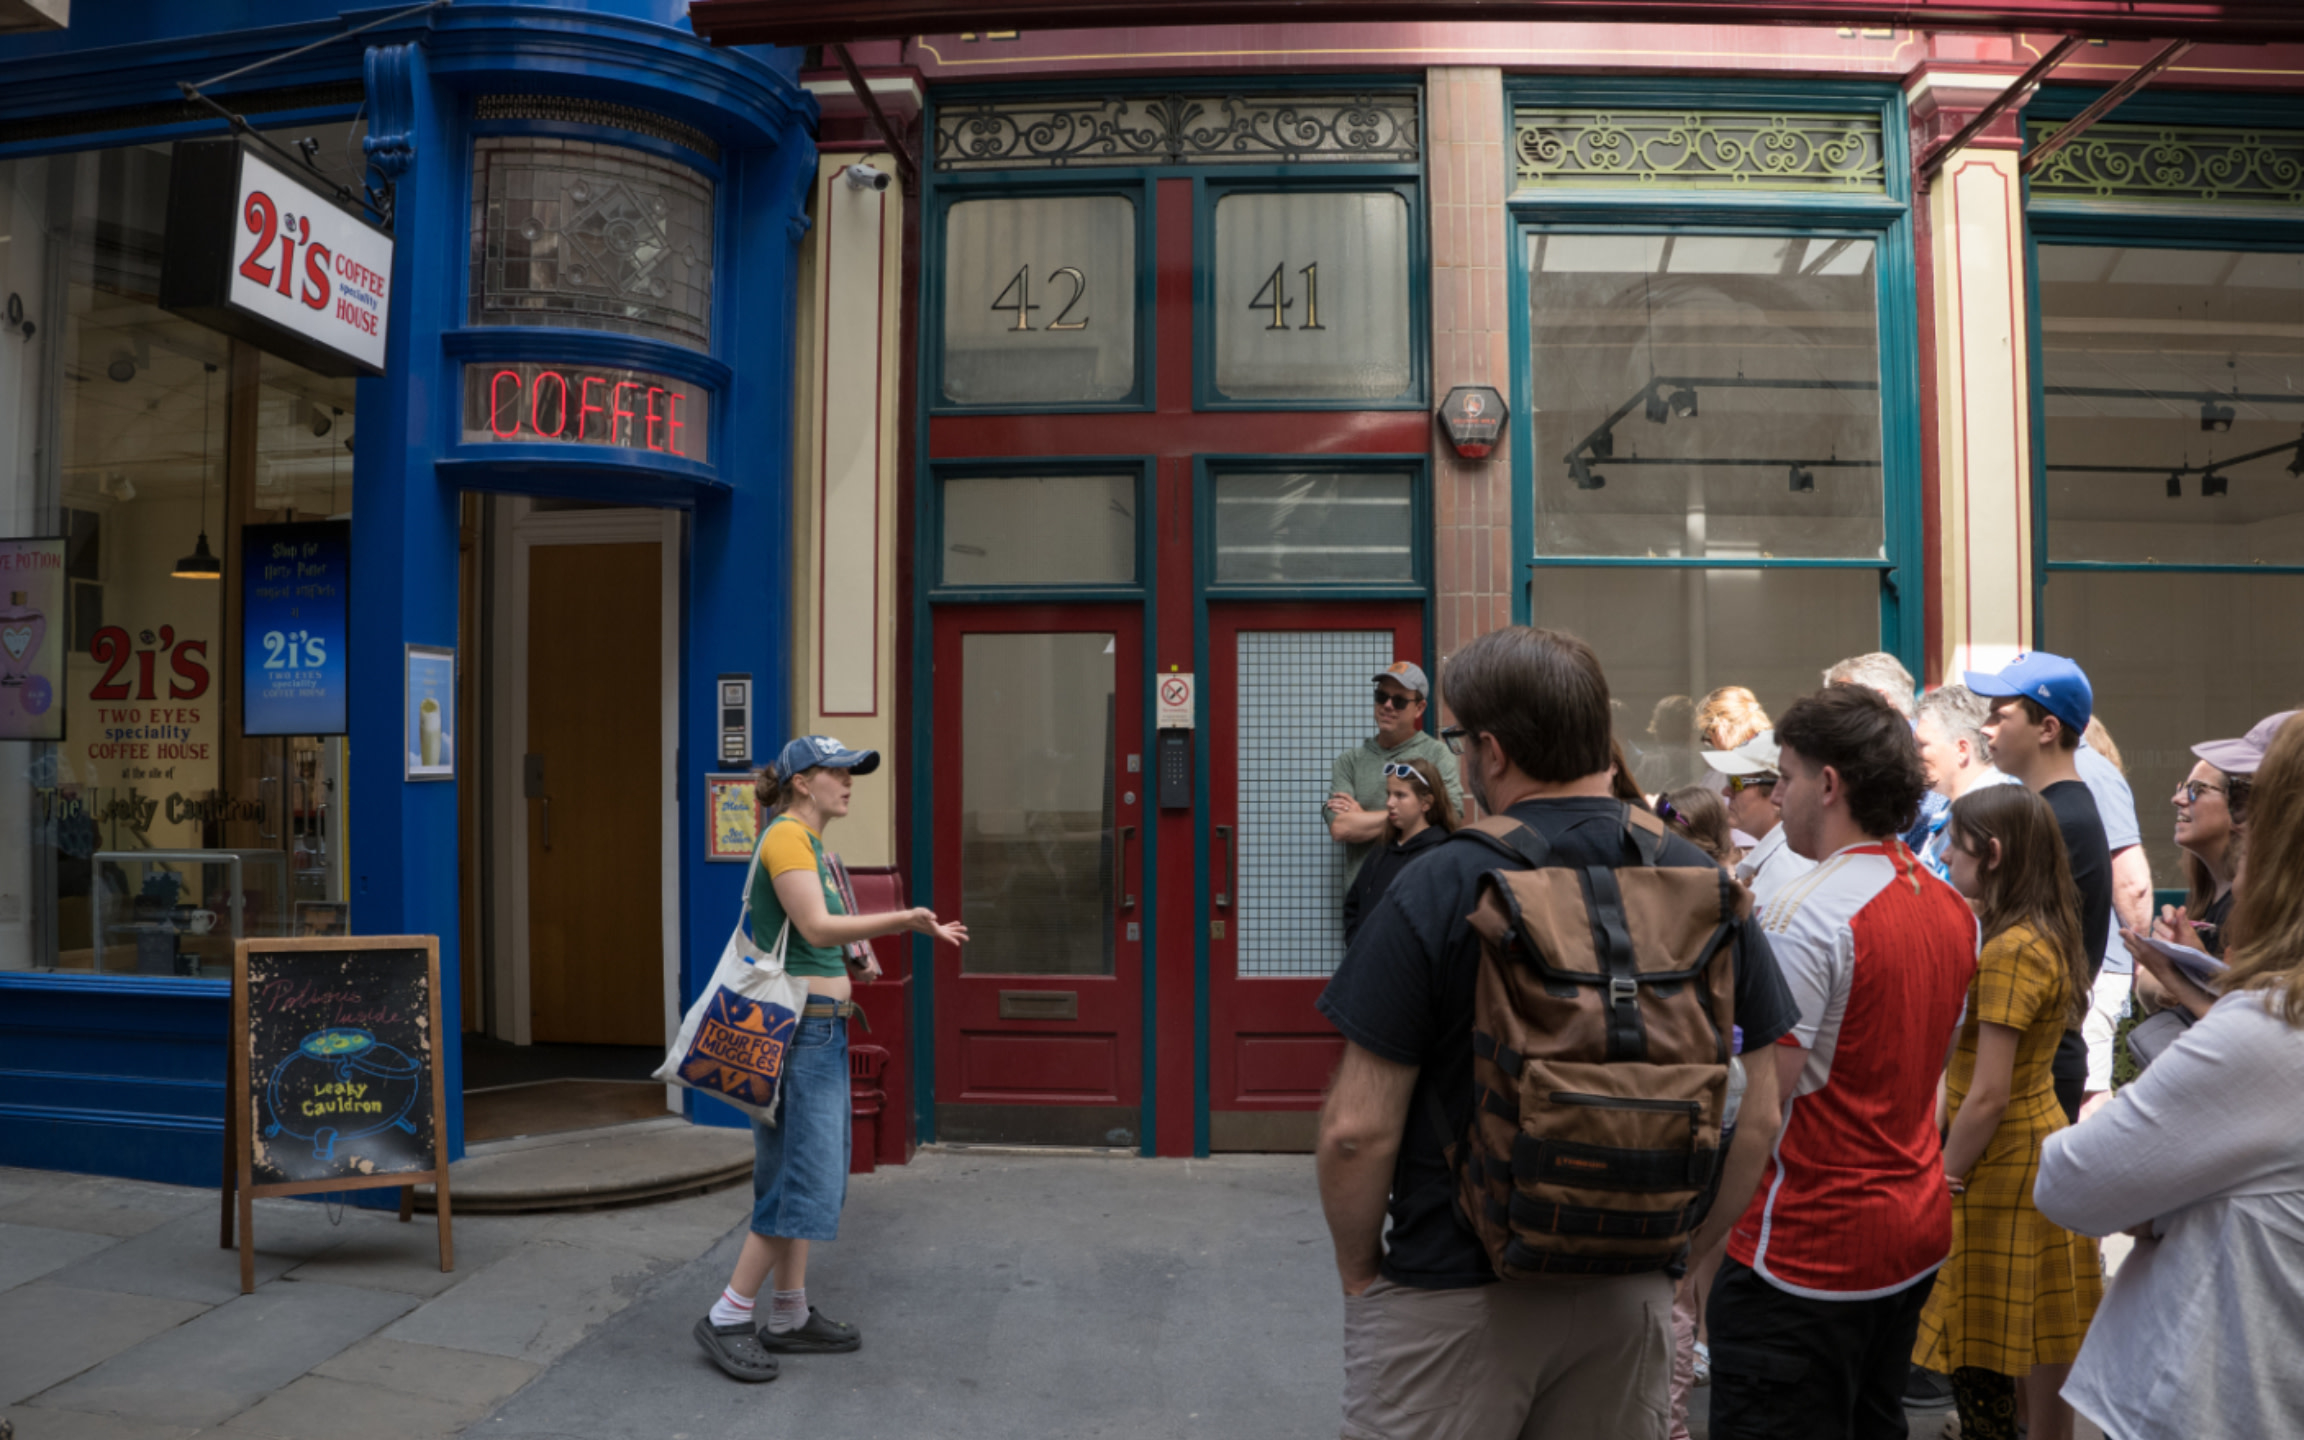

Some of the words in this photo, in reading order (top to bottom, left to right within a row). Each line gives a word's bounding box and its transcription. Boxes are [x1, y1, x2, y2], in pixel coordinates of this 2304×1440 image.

[335, 253, 385, 298] COFFEE
[339, 282, 378, 311] speciality
[990, 263, 1089, 331] 42
[1248, 261, 1326, 330] 41
[336, 297, 379, 336] HOUSE
[491, 370, 686, 456] COFFEE
[16, 552, 61, 568] POTION
[268, 671, 291, 680] TWO
[98, 709, 141, 724] TWO
[150, 709, 201, 724] EYES
[105, 725, 191, 741] speciality
[88, 743, 149, 760] COFFEE
[157, 743, 210, 760] HOUSE
[132, 766, 145, 779] the
[37, 787, 82, 822] The
[88, 786, 160, 832] Leaky
[166, 788, 265, 825] Cauldron
[262, 978, 361, 1013] Potions
[334, 1004, 405, 1024] Inside
[702, 1036, 776, 1072] MUGGLES
[708, 1022, 750, 1051] TOUR
[751, 1038, 780, 1058] FOR
[314, 1082, 368, 1100] Leaky
[301, 1096, 383, 1117] Cauldron
